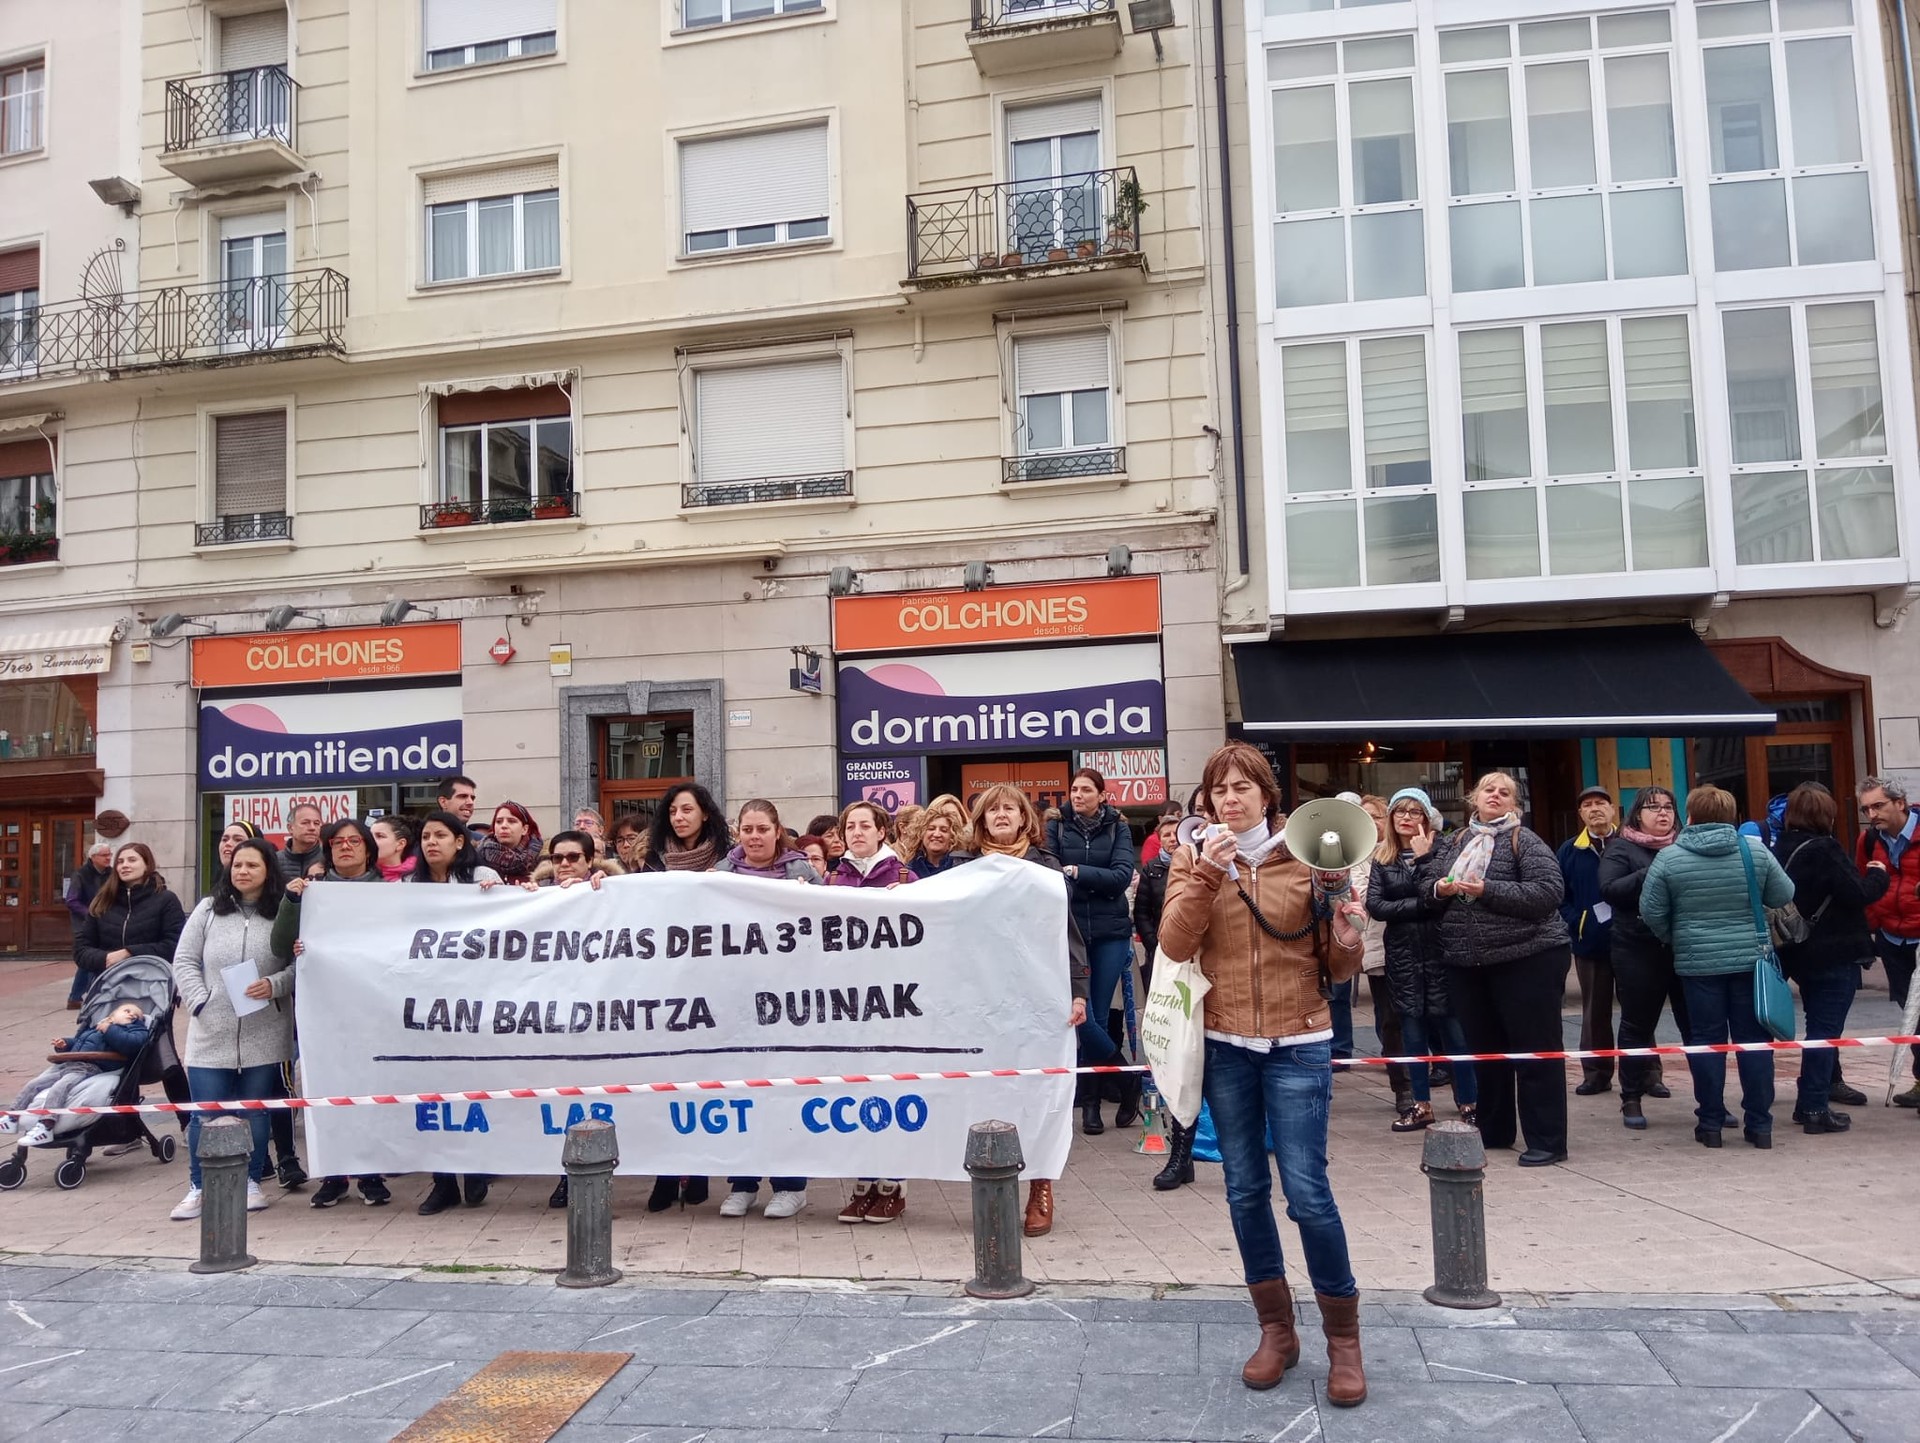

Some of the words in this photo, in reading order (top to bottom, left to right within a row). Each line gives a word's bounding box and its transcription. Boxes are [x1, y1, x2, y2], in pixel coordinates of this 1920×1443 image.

[902, 595, 949, 606] Fabricando
[899, 596, 1088, 633] COLCHONES
[1033, 626, 1060, 636] desde
[1063, 624, 1085, 634] 1966
[0, 656, 33, 674] Tres
[246, 638, 404, 671] COLCHONES
[358, 665, 381, 674] desde
[382, 664, 400, 673] 1966
[850, 698, 1151, 746] dormitienda
[208, 737, 457, 779] dormitienda
[644, 745, 658, 756] 10
[1085, 751, 1117, 776] FUERA
[1121, 749, 1160, 776] STOCKS
[846, 761, 894, 771] GRANDES
[847, 769, 910, 781] DESCUENTOS
[1036, 779, 1060, 787] zona
[232, 797, 282, 830] FUERA
[409, 927, 656, 963] RESIDENCIAS
[666, 924, 713, 959] DE
[721, 922, 769, 955] LA
[821, 913, 925, 952] EDAD
[403, 997, 483, 1034] LAN
[493, 997, 716, 1034] BALDINTZA
[755, 982, 923, 1027] DUINAK
[415, 1101, 490, 1133] ELA
[540, 1102, 615, 1135] LAB
[669, 1098, 753, 1135] UGT
[801, 1093, 928, 1133] CCOO
